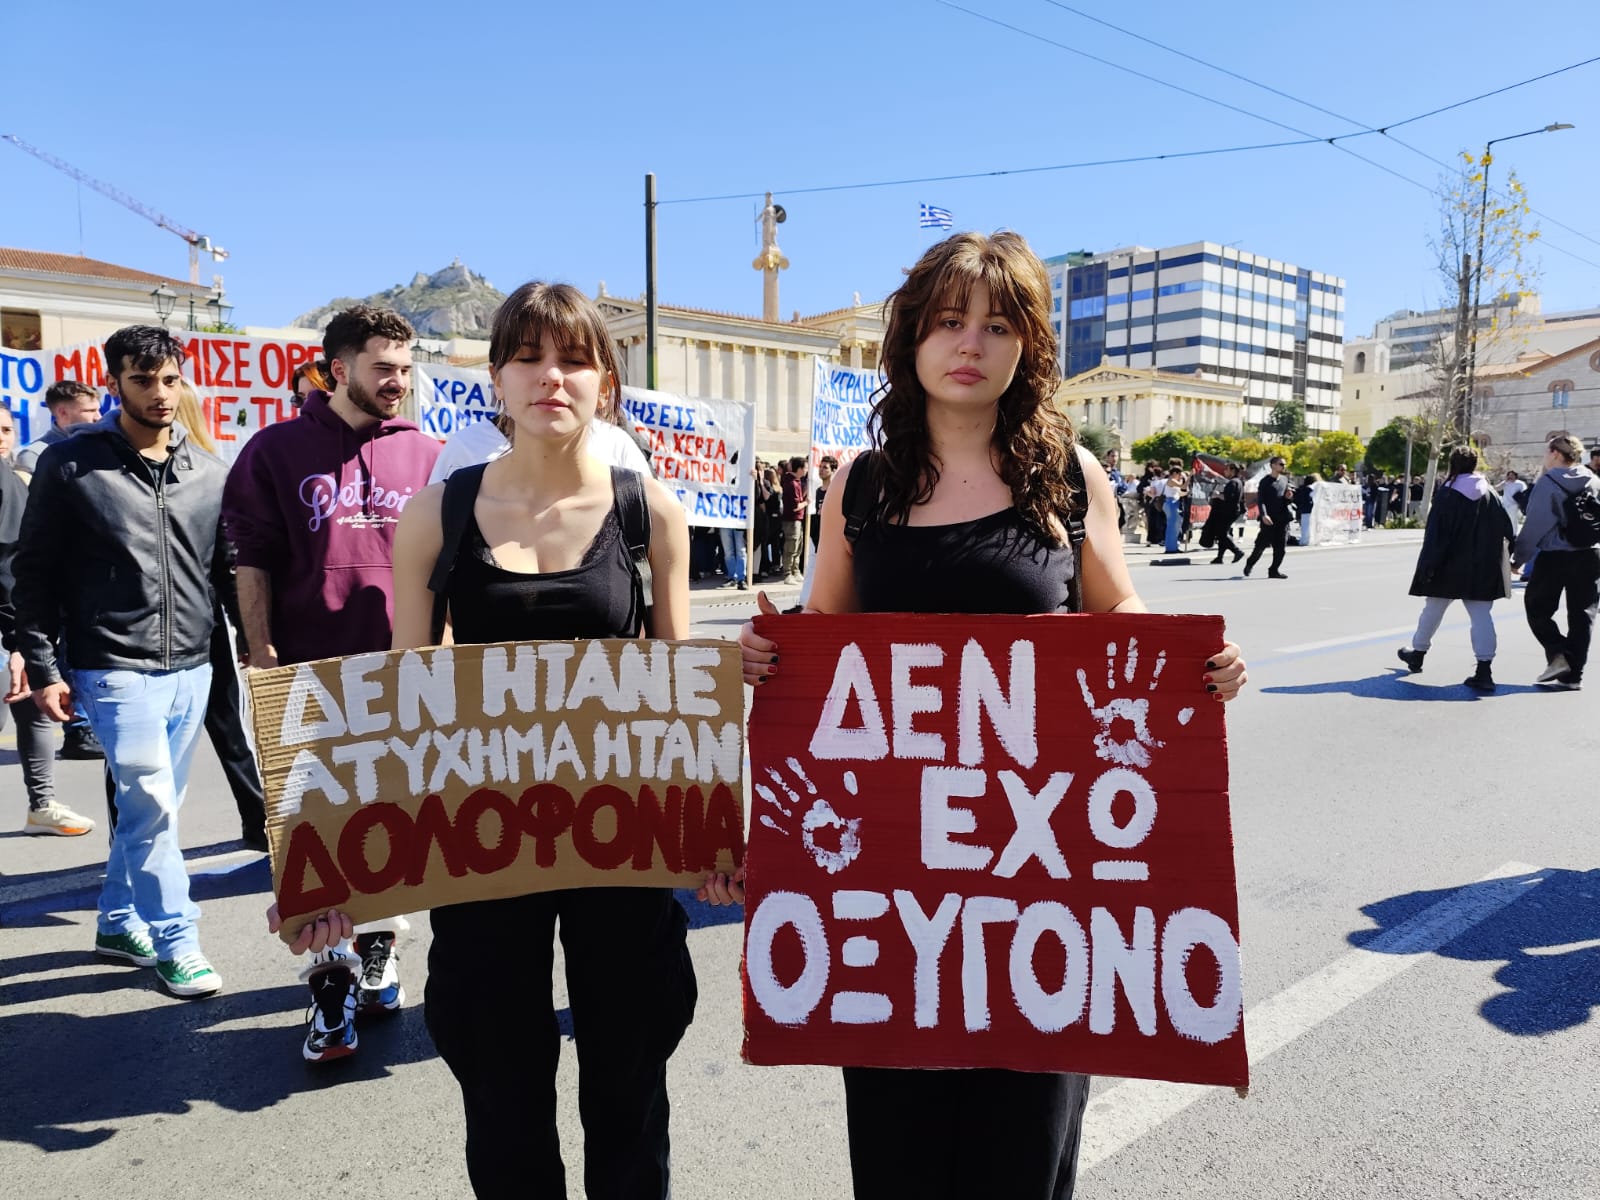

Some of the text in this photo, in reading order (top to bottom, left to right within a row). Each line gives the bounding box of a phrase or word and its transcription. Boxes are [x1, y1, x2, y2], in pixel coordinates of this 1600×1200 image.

[54, 346, 107, 388] ΜΑ
[172, 338, 253, 389] ΜΙΣΕ
[654, 455, 725, 483] ΤΕΜΠΩΝ
[673, 432, 727, 460] ΧΕΡΙΑ
[299, 468, 412, 532] Detroi
[280, 639, 722, 746] ΔΕΝ ΗΤΑΝΕ
[808, 637, 1039, 769] ΔΕΝ
[278, 719, 741, 816] ΑΤΥΧΗΜΑ ΗΤΑΝ
[278, 781, 745, 921] ΔΟΛΟΦΟΝΙΑ
[921, 765, 1158, 881] ΕΧΩ
[746, 889, 1243, 1046] ΟΞΥΓΟΝΟ
